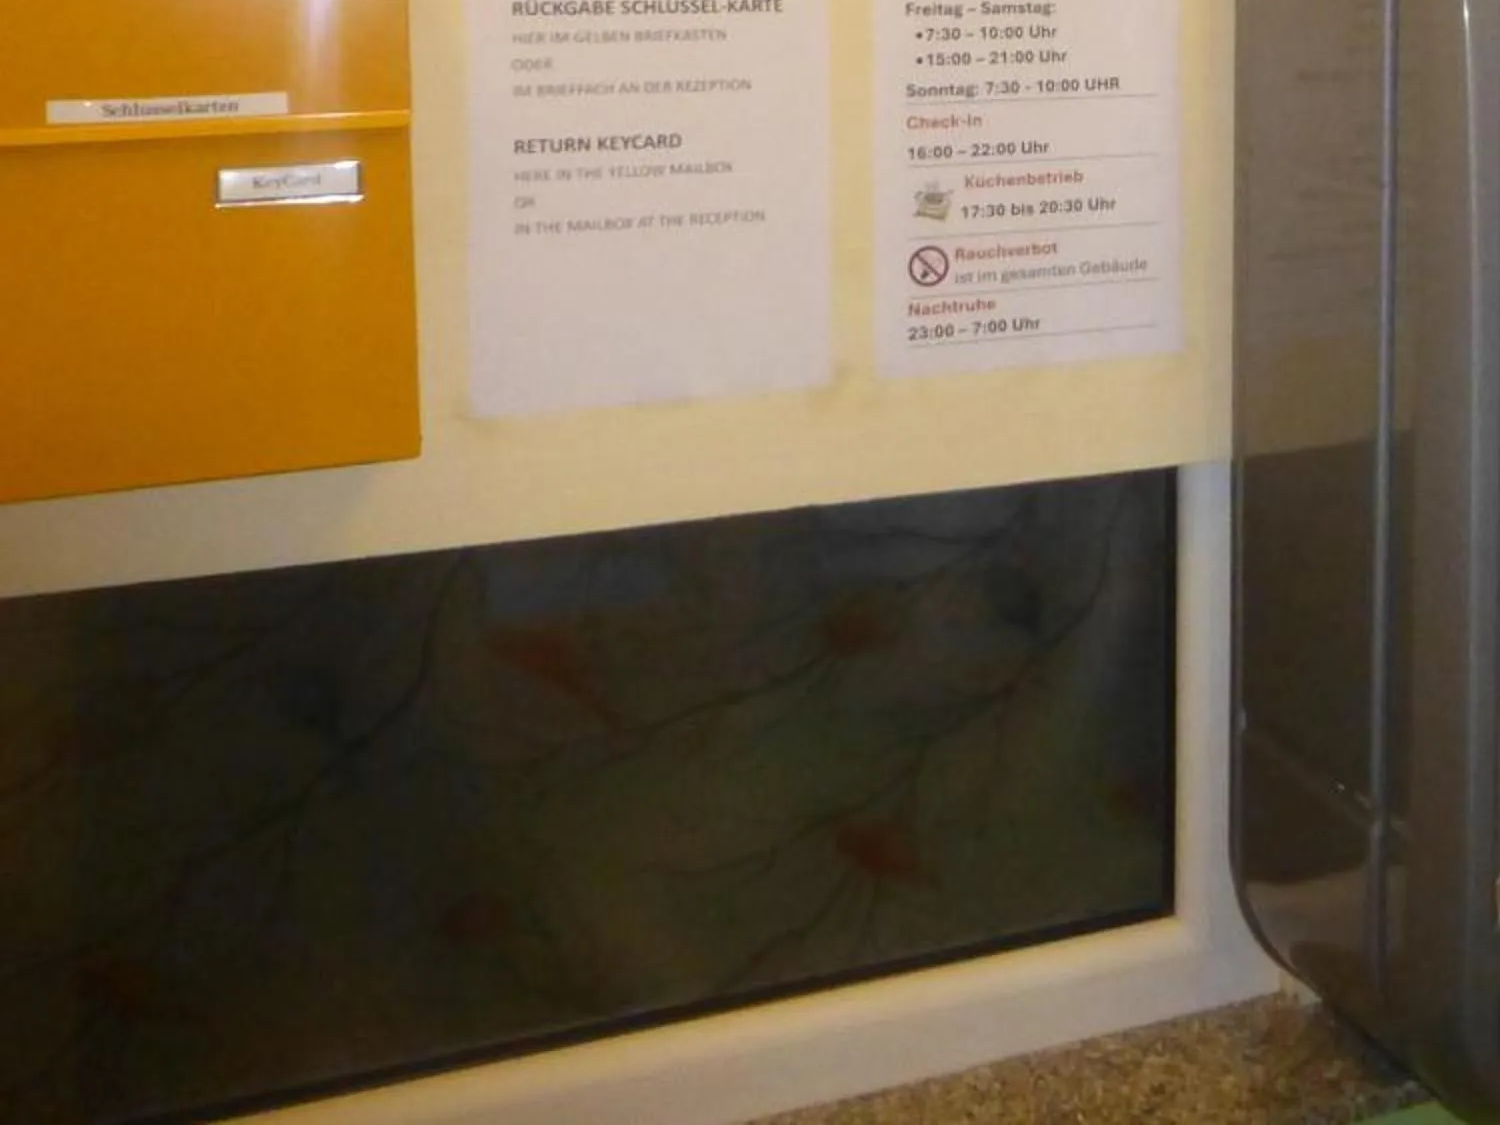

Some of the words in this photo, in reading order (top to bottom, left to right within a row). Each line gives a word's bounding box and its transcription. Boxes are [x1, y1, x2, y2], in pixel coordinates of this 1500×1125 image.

[905, 2, 964, 18] Freitag
[980, 0, 1057, 16] Samstag:
[925, 27, 961, 41] 7:30
[980, 26, 1023, 40] 10:00
[1029, 25, 1057, 39] Uhr
[927, 52, 971, 66] 15:00
[990, 51, 1034, 65] 21:00
[1039, 50, 1067, 63] Uhr
[906, 82, 979, 98] Sonntag:
[985, 81, 1020, 95] 7:30
[1037, 79, 1079, 93] 10:00
[1085, 77, 1120, 91] UHR
[513, 137, 591, 155] RETURN
[597, 133, 683, 153] KEYCARD
[908, 146, 953, 160] 16:00
[971, 143, 1016, 157] 22:00
[1021, 141, 1050, 156] Uhr
[576, 167, 603, 182] THE
[608, 164, 666, 180] YELLOW
[961, 204, 1005, 219] 17:30
[1011, 202, 1034, 217] bis
[1040, 199, 1083, 215] 20:30
[1088, 197, 1116, 212] Uhr
[955, 242, 1058, 262] Rauchverbot
[977, 268, 997, 282] im
[908, 299, 996, 317] Nachtruhe
[908, 326, 955, 341] 23:00
[973, 321, 1007, 336] 7:00
[1012, 319, 1040, 332] Uhr
